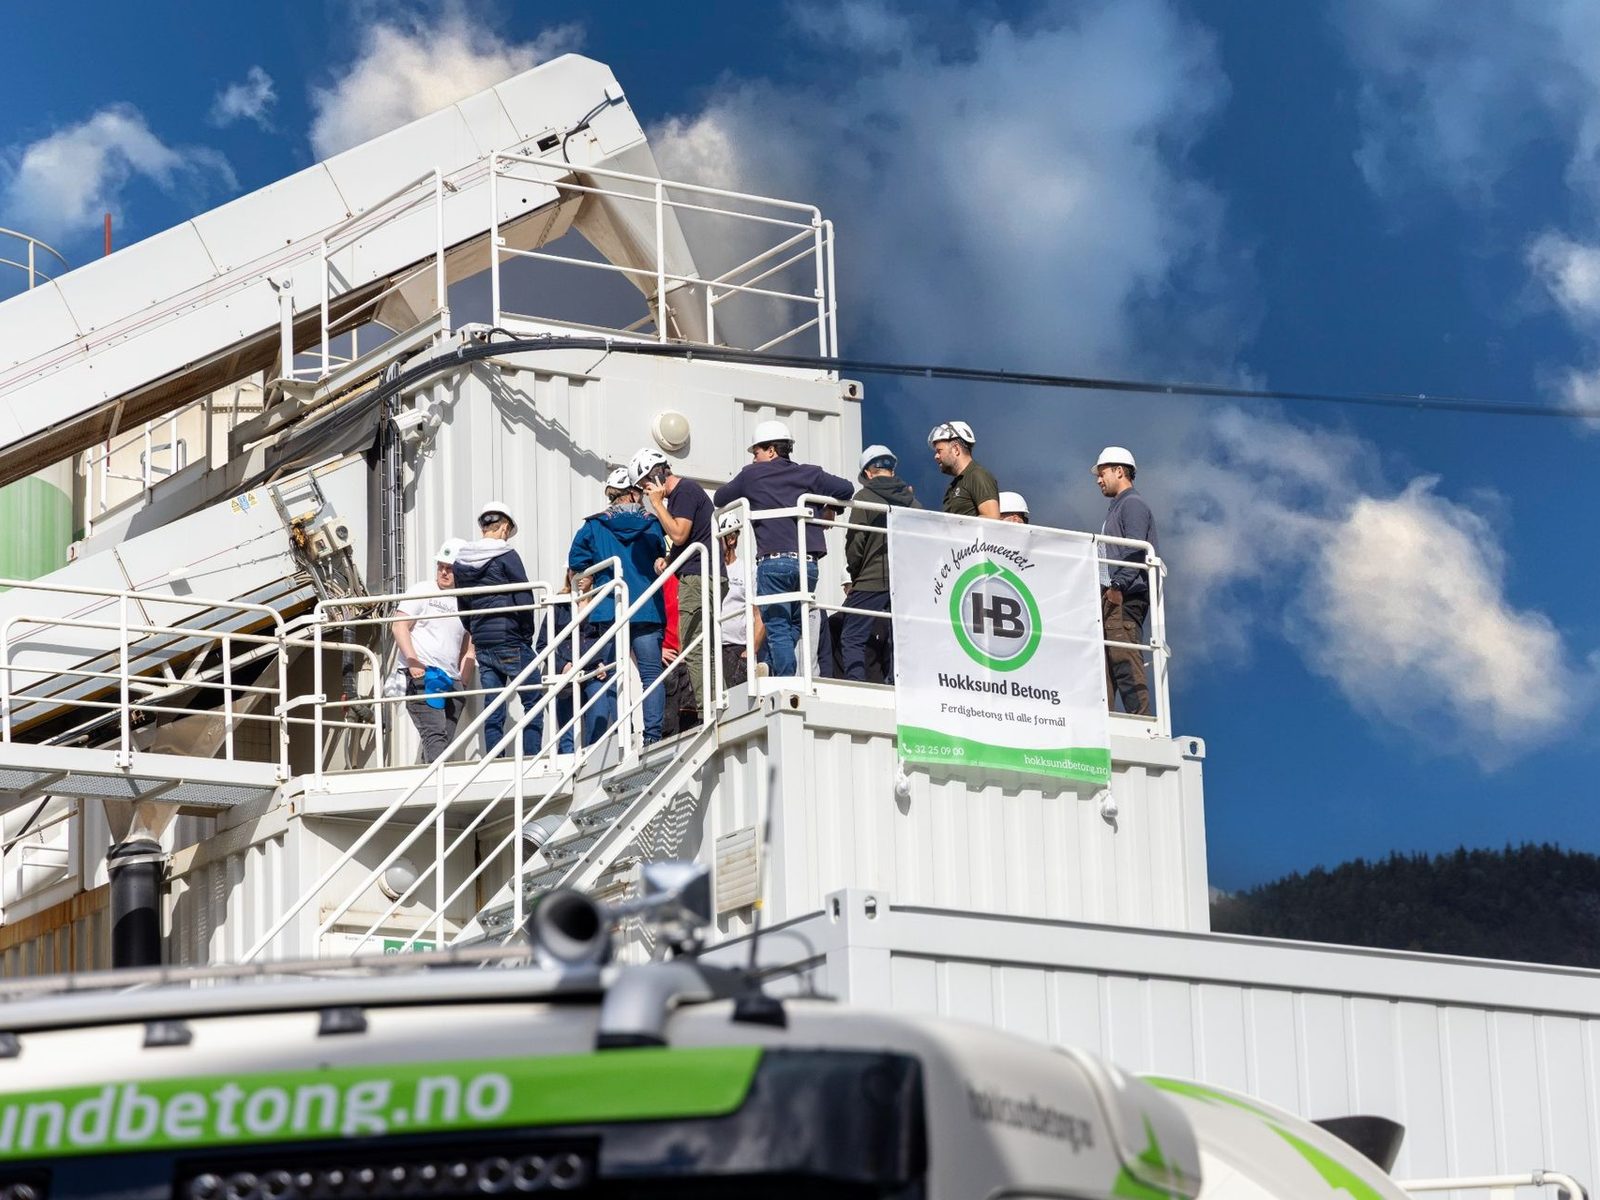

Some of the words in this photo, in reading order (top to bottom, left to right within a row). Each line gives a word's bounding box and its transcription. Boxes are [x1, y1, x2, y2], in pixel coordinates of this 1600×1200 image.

[971, 592, 1025, 639] HB
[938, 672, 1008, 695] Hokksund
[1011, 682, 1061, 705] Betong
[940, 703, 1003, 721] Ferdigbetong
[1005, 712, 1015, 721] til
[1016, 713, 1032, 723] alle
[1034, 715, 1066, 727] formål
[914, 744, 926, 754] 32
[927, 746, 939, 755] 25
[940, 747, 951, 756] 09
[952, 747, 965, 756] 00
[1023, 754, 1108, 775] hokksundbetong.no
